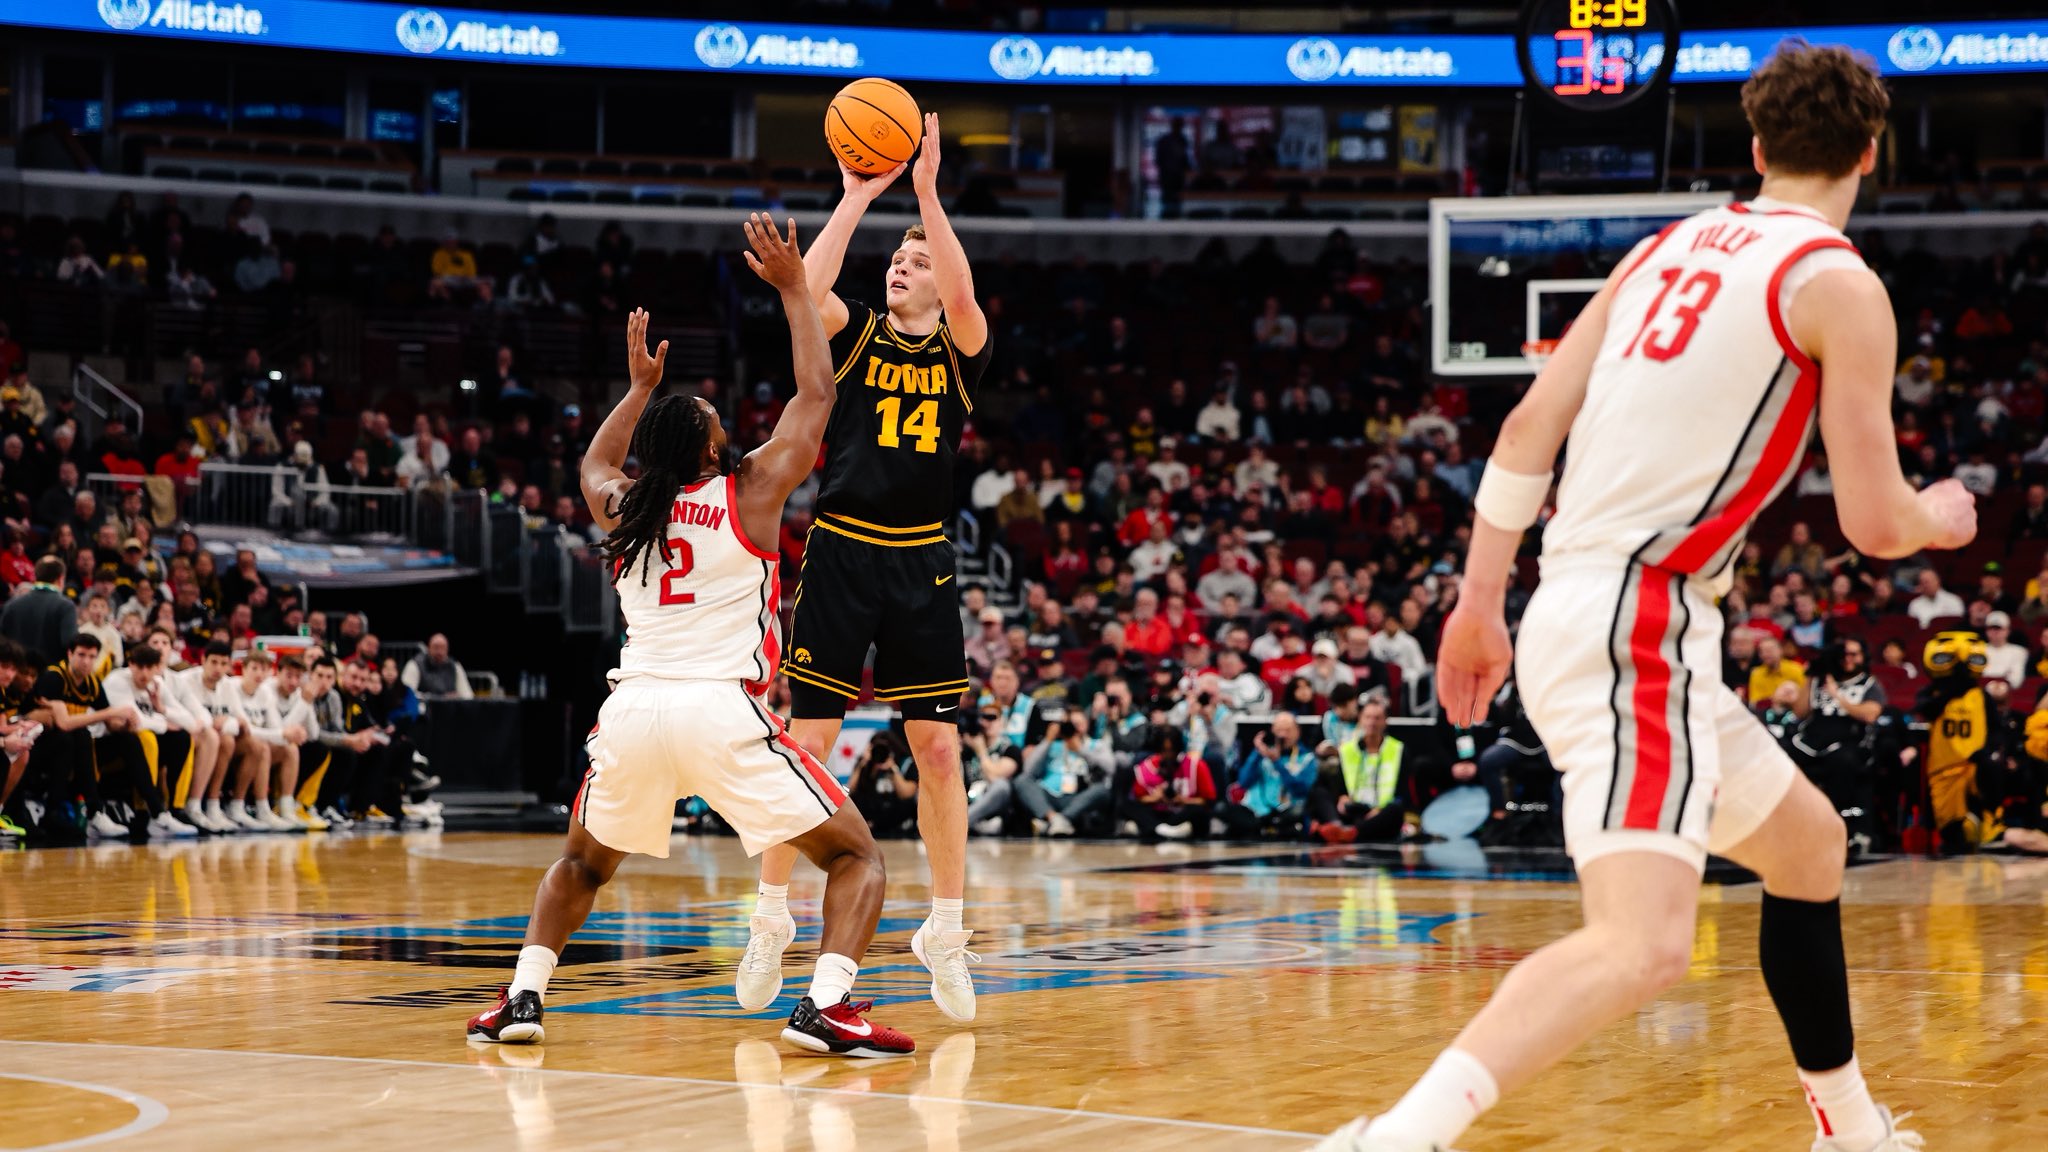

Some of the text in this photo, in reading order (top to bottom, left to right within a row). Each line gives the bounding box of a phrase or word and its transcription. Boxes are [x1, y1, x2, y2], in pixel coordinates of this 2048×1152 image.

[149, 0, 264, 36] Allstate
[1569, 0, 1648, 29] 8:39
[446, 20, 560, 57] Allstate
[745, 33, 859, 69] Allstate
[1041, 44, 1155, 77] Allstate
[1338, 46, 1453, 78] Allstate
[1622, 267, 1722, 364] 13
[864, 355, 948, 395] IOWA
[875, 396, 941, 454] 14
[658, 536, 696, 607] 2
[1942, 718, 1972, 739] 00
